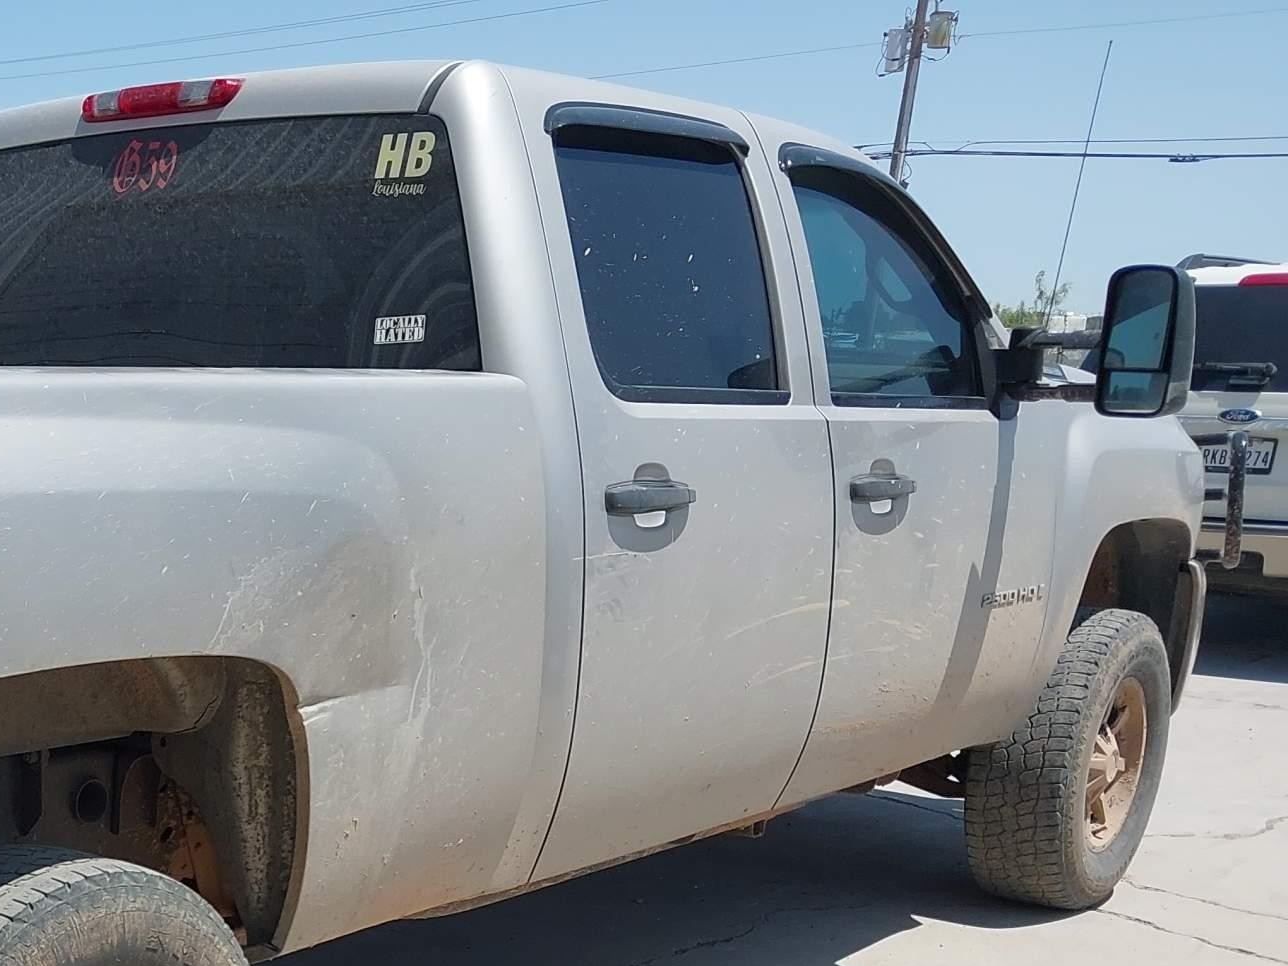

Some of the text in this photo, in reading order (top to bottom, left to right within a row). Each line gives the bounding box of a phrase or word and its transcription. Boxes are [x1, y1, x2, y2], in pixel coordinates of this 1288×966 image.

[374, 131, 436, 179] HB
[372, 180, 427, 198] Louisiana
[376, 317, 424, 330] LOCALLY
[376, 328, 423, 342] HATED
[1203, 448, 1270, 466] RKB 274
